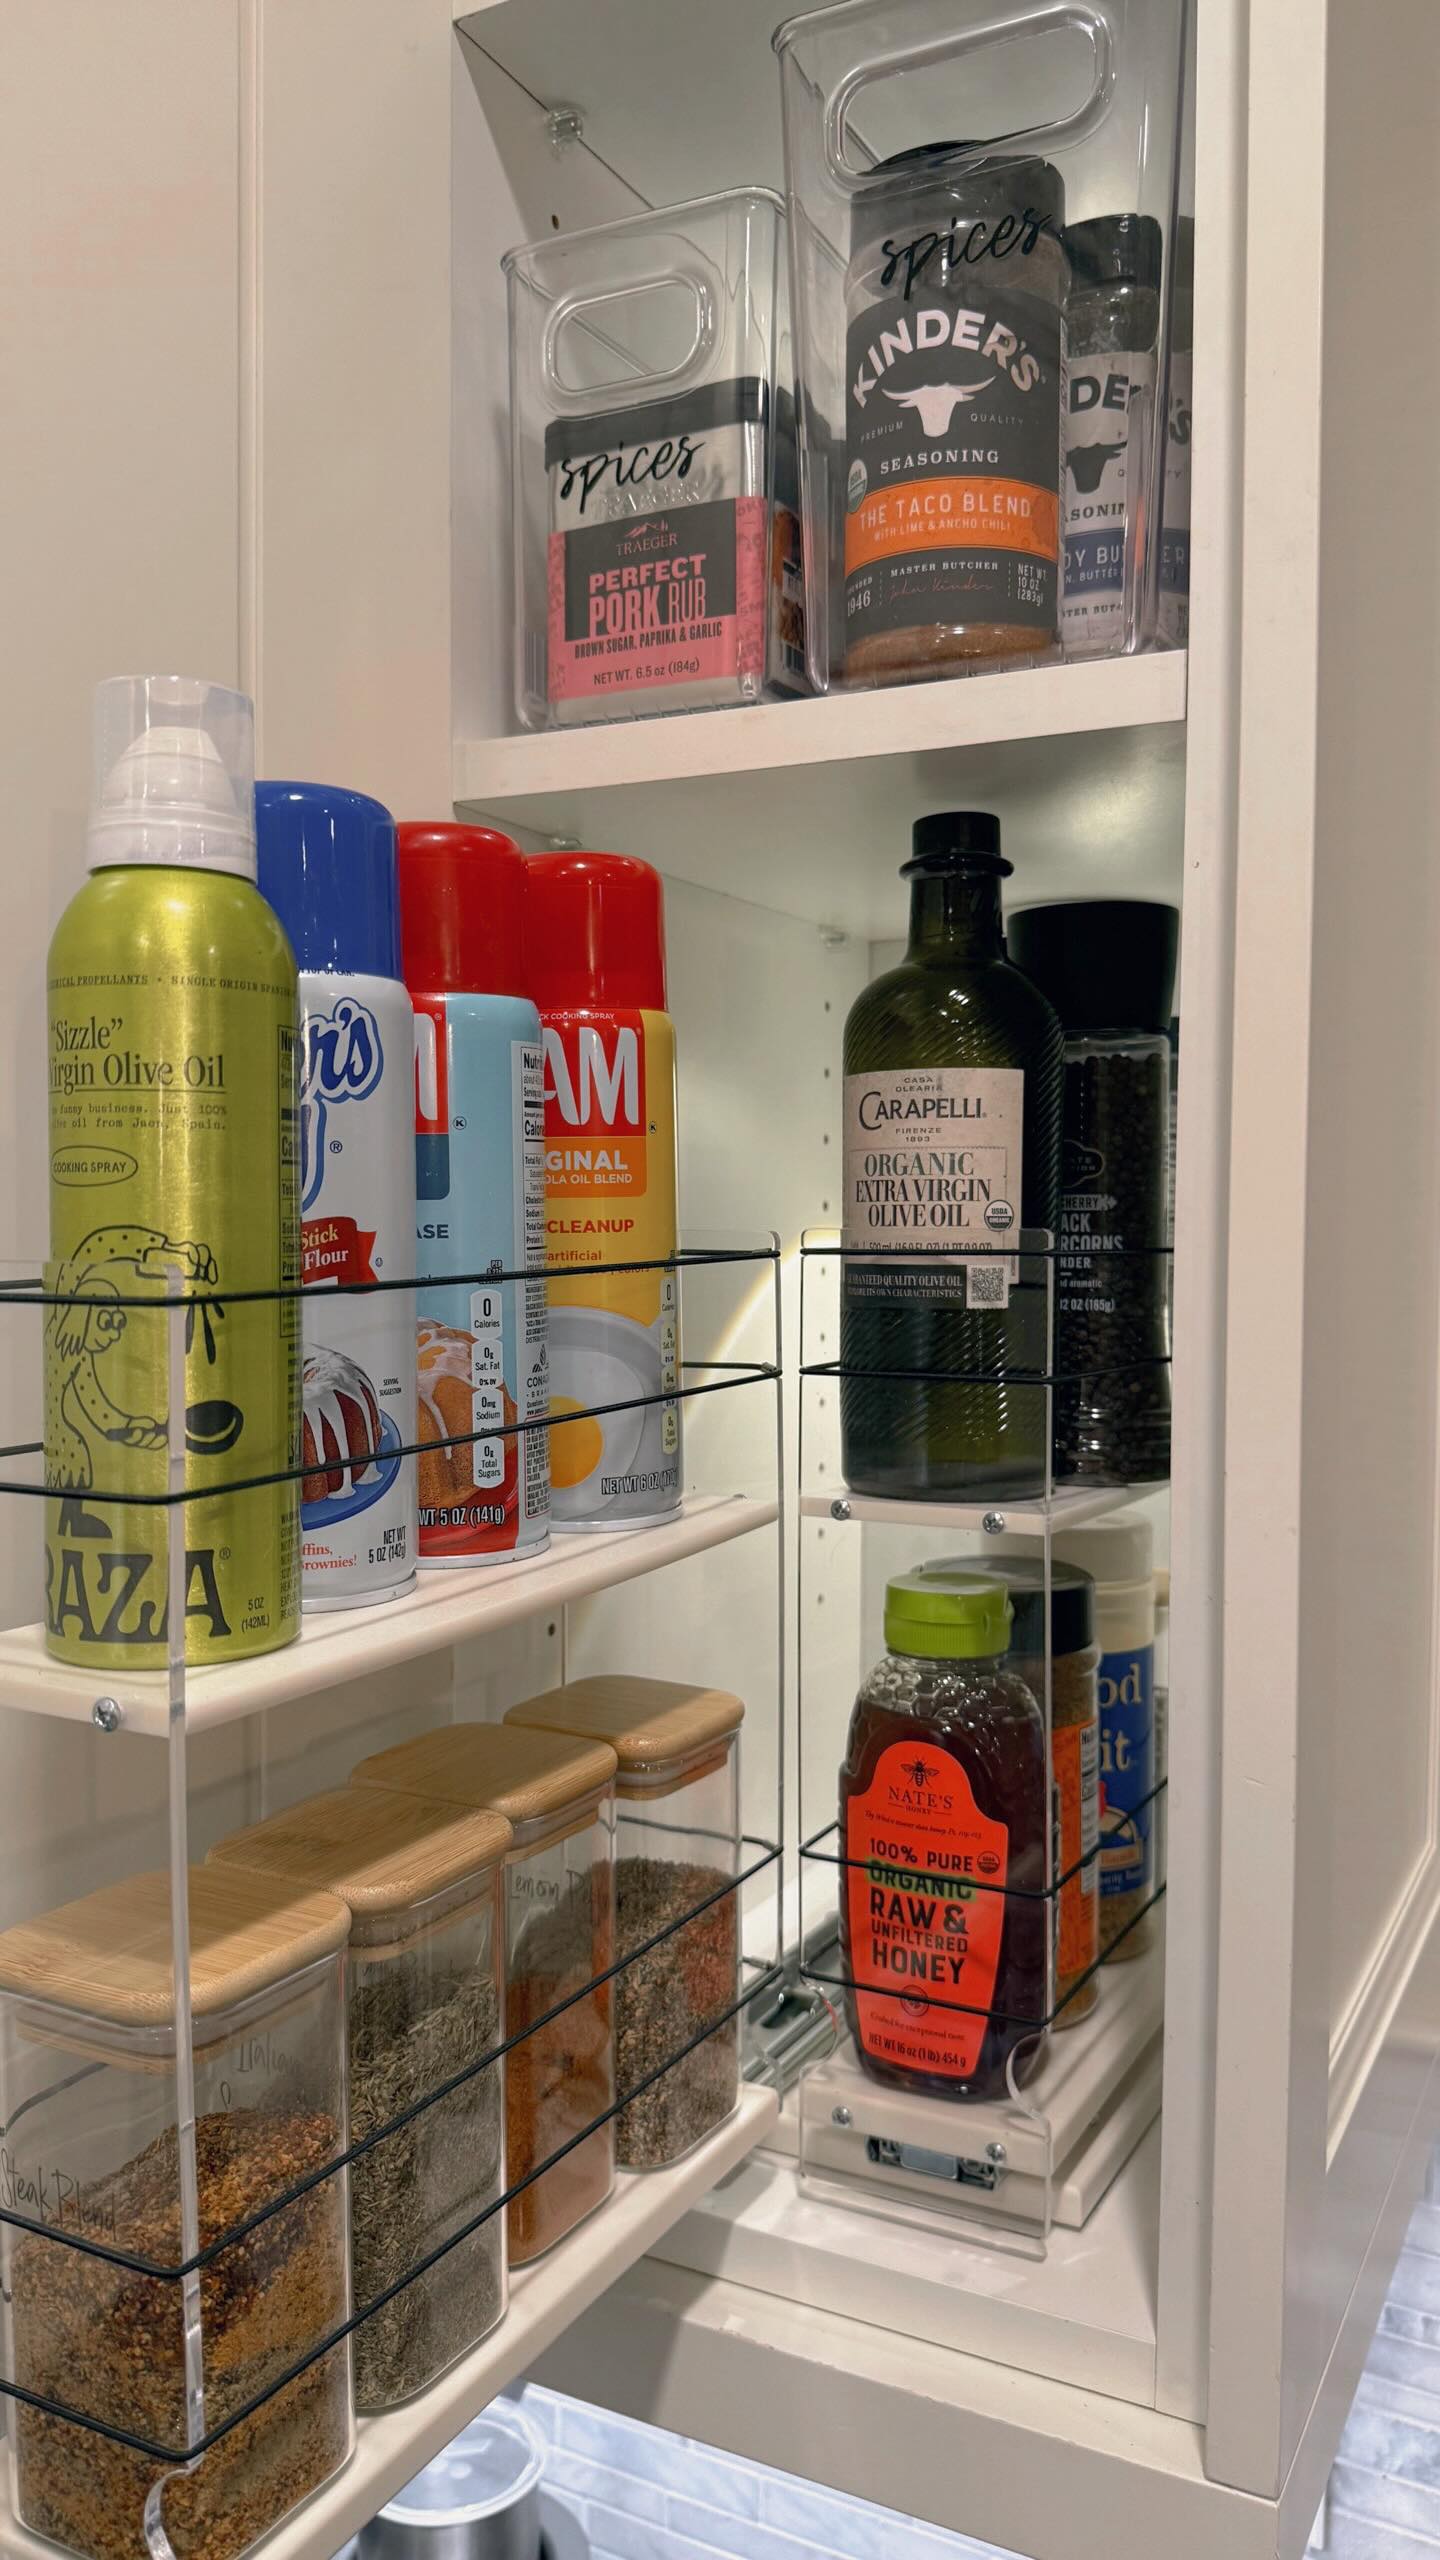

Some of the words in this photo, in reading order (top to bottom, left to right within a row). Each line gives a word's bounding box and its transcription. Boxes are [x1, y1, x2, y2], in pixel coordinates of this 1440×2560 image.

[880, 207, 1052, 301] spices
[853, 309, 1040, 409] KINDER'S
[860, 421, 904, 443] PREMIUM
[970, 412, 1024, 425] QUALITY
[880, 450, 999, 475] SEASONING
[560, 436, 706, 514] spices
[860, 504, 887, 531] THE
[896, 493, 952, 518] TACO
[962, 493, 1032, 518] BLEND
[874, 527, 897, 542] WITH
[900, 522, 924, 536] LIME
[927, 521, 936, 530] &
[938, 518, 977, 530] ANCHO
[981, 519, 1011, 531] CHILI
[615, 533, 678, 557] TRAEGER
[589, 554, 707, 594] PERFECT
[890, 563, 936, 577] MASTER
[942, 561, 998, 571] BUTCHER
[1017, 563, 1034, 577] NET
[1018, 577, 1027, 588] 10
[589, 586, 661, 638] PORK
[668, 578, 707, 625] RUB
[848, 590, 871, 617] 1946
[575, 639, 605, 659] BROWN
[639, 628, 677, 648] PAPRIKA
[679, 627, 687, 642] &
[689, 622, 722, 641] GARLIC
[593, 672, 611, 685] NET
[636, 665, 652, 679] 6.5
[654, 665, 665, 675] oz
[668, 658, 700, 676] (184g)
[77, 974, 149, 986] PROPELLANTS
[171, 976, 216, 987] SINGLE
[219, 978, 258, 991] ORIGIN
[551, 1012, 588, 1020] COOKING
[590, 1012, 615, 1020] SPRAY
[103, 1052, 174, 1086] Olive
[184, 1054, 226, 1088] Oil
[89, 1103, 148, 1114] business.
[859, 1091, 981, 1131] CARAPELLI
[96, 1118, 123, 1128] from
[53, 1162, 88, 1173] COOKING
[91, 1161, 127, 1173] SPRAY
[864, 1152, 974, 1177] ORGANIC
[570, 1173, 591, 1185] OIL
[594, 1173, 633, 1184] BLEND
[856, 1179, 909, 1202] EXTRA
[912, 1178, 992, 1202] VIRGIN
[868, 1203, 926, 1228] OLIVE
[929, 1203, 970, 1228] OIL
[991, 1207, 1008, 1215] USDA
[301, 1224, 339, 1249] Stick
[547, 1219, 634, 1234] CLEANUP
[304, 1248, 348, 1270] Flour
[548, 1250, 602, 1261] artificial
[883, 1275, 919, 1286] QUALITY
[919, 1275, 946, 1286] OLIVE
[946, 1275, 962, 1286] OIL
[876, 1288, 892, 1296] OWN
[892, 1288, 962, 1298] CHARACTERISTICS
[1070, 1299, 1083, 1310] OZ
[483, 1298, 491, 1316] 0
[474, 1319, 500, 1329] Calories
[484, 1347, 494, 1360] 0g
[475, 1361, 489, 1371] Sat.
[490, 1361, 500, 1370] Fat
[481, 1396, 496, 1409] 0mg
[476, 1411, 500, 1420] Sodium
[481, 1459, 498, 1468] Total
[484, 1445, 494, 1458] 0g
[478, 1469, 501, 1479] Sugars
[602, 1477, 620, 1496] NET
[622, 1475, 639, 1494] WT
[640, 1474, 647, 1491] 6
[648, 1472, 659, 1490] OZ
[439, 1508, 448, 1526] 5
[451, 1507, 466, 1525] OZ
[469, 1504, 505, 1528] (141g)
[383, 1528, 396, 1545] NET
[397, 1525, 406, 1541] WT
[301, 1553, 357, 1571] rownies!
[368, 1549, 374, 1564] 5
[376, 1547, 387, 1562] OZ
[48, 1549, 232, 1643] AZA
[248, 1599, 254, 1610] 5
[254, 1597, 265, 1609] OZ
[888, 1786, 953, 1810] NATE'S
[869, 1838, 918, 1864] 100%
[927, 1850, 974, 1873] PURE
[869, 1862, 973, 1900] ORGANIC
[870, 1887, 937, 1929] RAW
[943, 1904, 969, 1934] &
[871, 1918, 968, 1953] UNFILTERED
[871, 1939, 965, 1984] HONEY
[869, 2032, 882, 2047] NET
[884, 2037, 896, 2050] WT
[897, 2041, 905, 2055] 16
[906, 2047, 916, 2057] oz
[942, 2051, 958, 2065] 454
[960, 2055, 966, 2068] g
[0, 2148, 53, 2222] Steak
